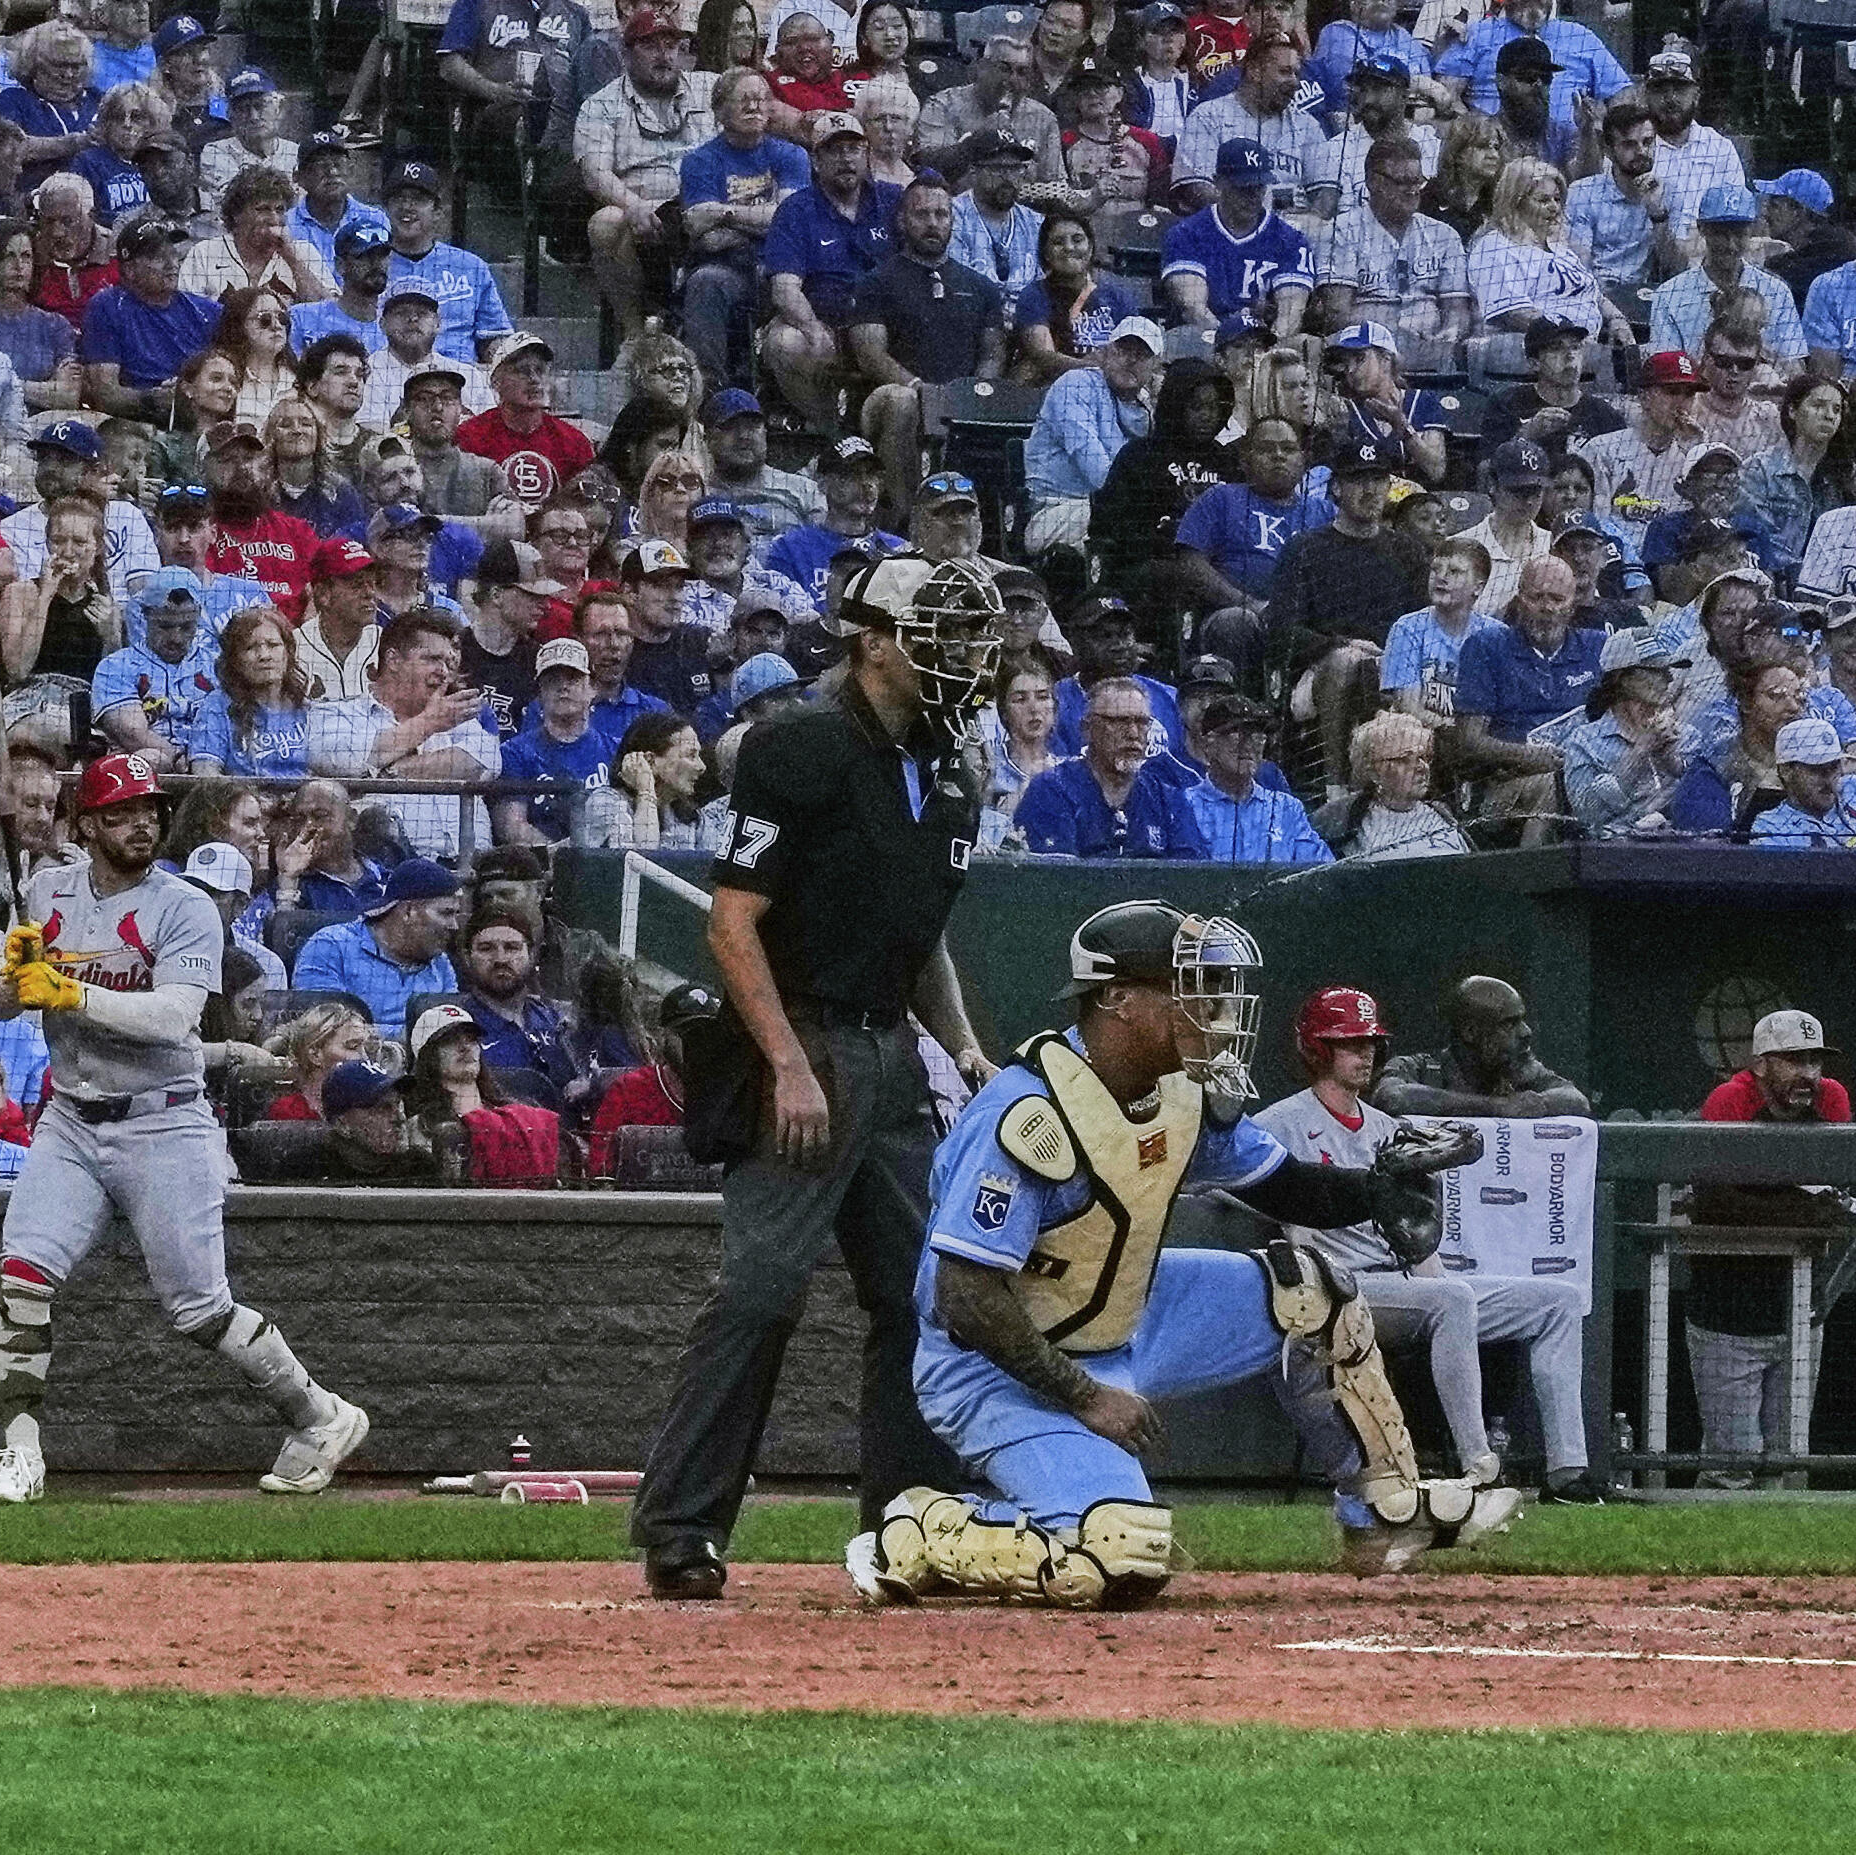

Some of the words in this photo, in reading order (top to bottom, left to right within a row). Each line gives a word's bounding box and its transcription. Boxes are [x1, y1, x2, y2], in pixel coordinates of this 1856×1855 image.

[52, 423, 70, 440] KC
[1521, 451, 1537, 470] KC
[978, 1192, 1007, 1226] KC
[1549, 1150, 1568, 1247] BODYARMOR
